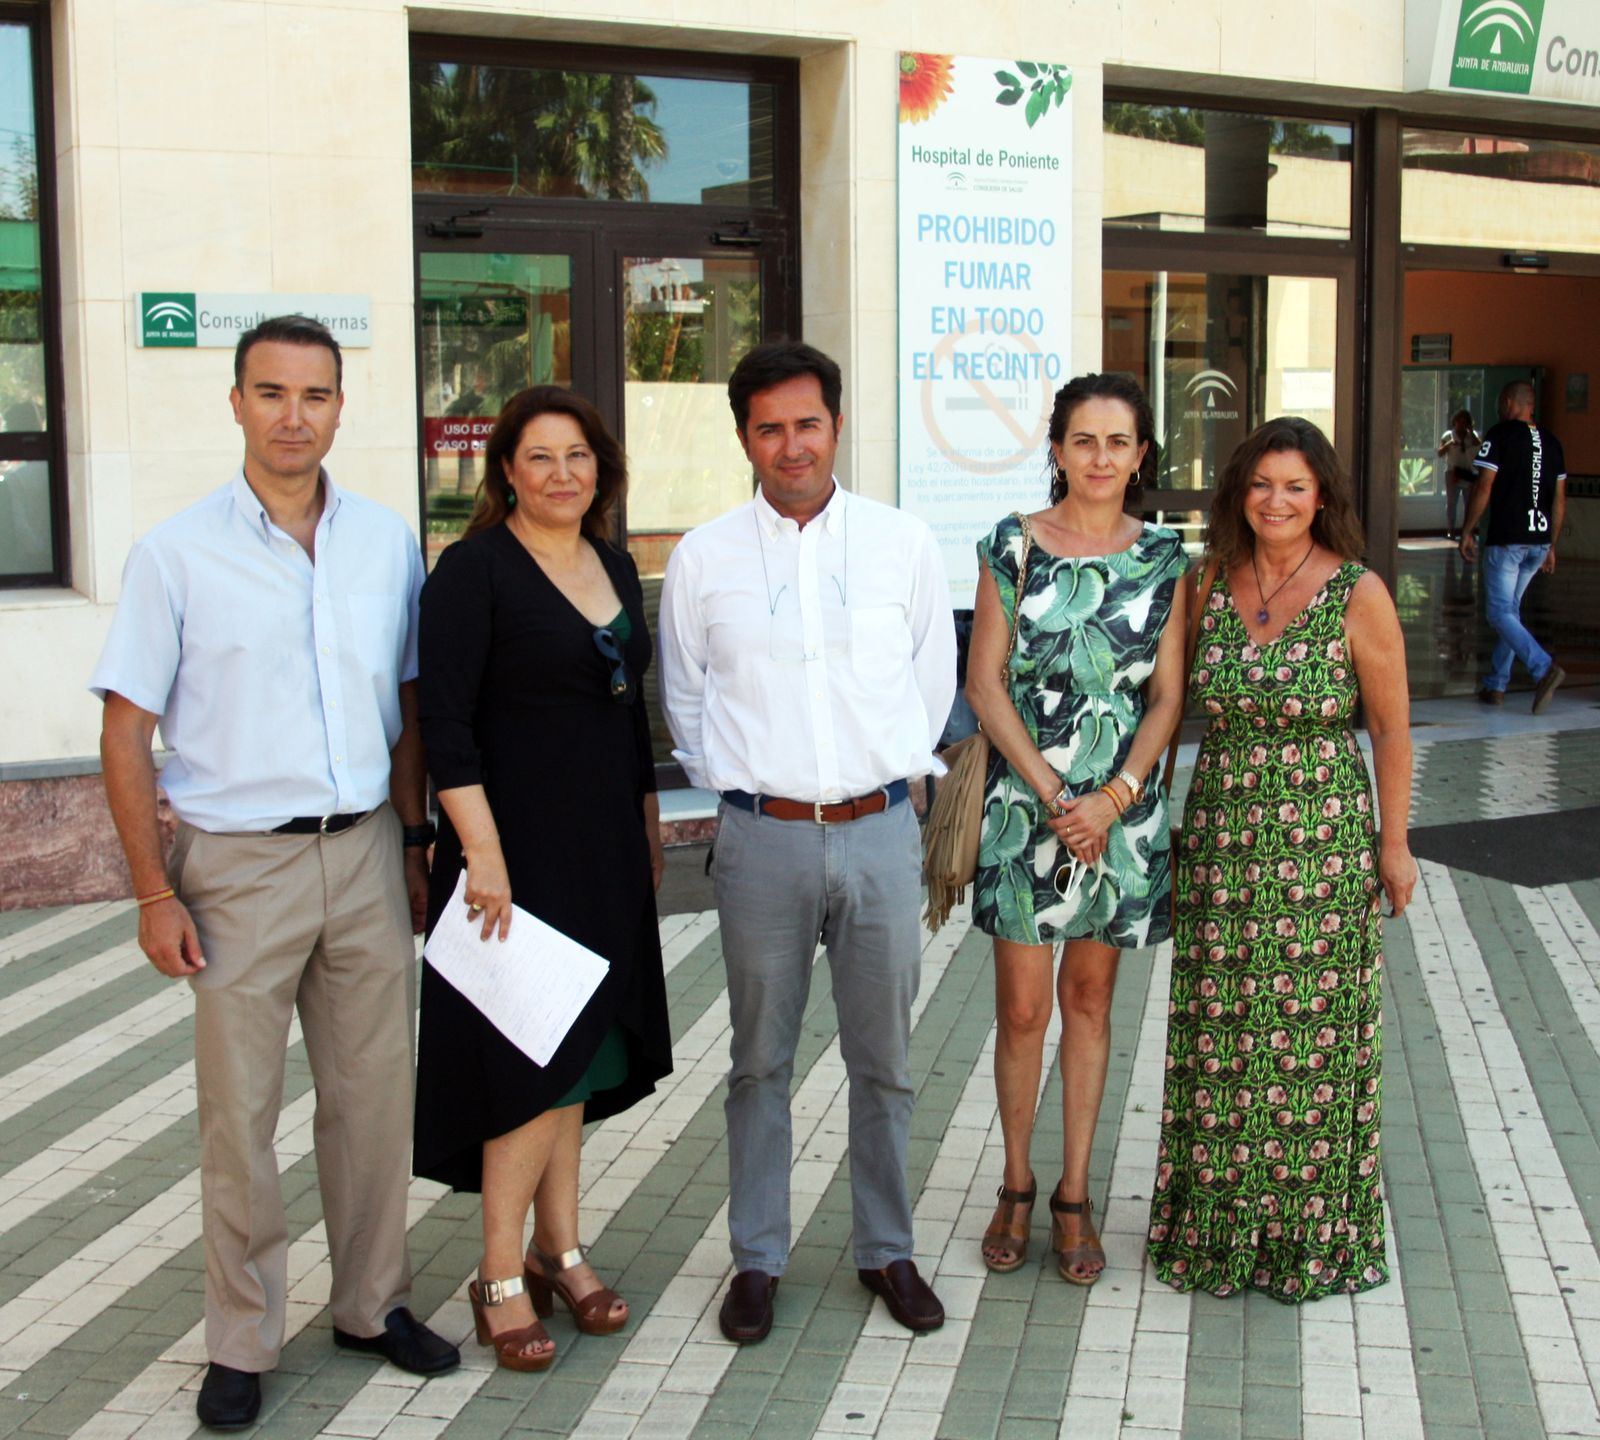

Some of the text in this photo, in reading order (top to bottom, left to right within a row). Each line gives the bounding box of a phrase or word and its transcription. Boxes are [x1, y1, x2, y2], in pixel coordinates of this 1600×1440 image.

[1456, 56, 1529, 75] JUNTA DE ANDALUCIA
[1546, 36, 1600, 78] Con
[912, 145, 1060, 170] Hospital de Poniente
[917, 214, 1055, 247] PROHIBIDO
[944, 261, 1031, 291] FUMAR
[931, 306, 1044, 336] EN TODO
[912, 352, 1061, 381] EL RECINTO
[444, 424, 470, 435] USO
[434, 440, 468, 451] CASO
[950, 446, 982, 457] informa
[984, 446, 996, 456] de
[997, 448, 1012, 458] que
[908, 462, 924, 474] Ley
[927, 462, 966, 473] 42/2010
[908, 478, 928, 488] todo
[929, 478, 938, 487] el
[940, 478, 969, 488] recinto
[917, 493, 930, 504] los
[932, 492, 994, 505] aparcamientos
[1003, 492, 1026, 502] zonas
[1527, 508, 1548, 532] 13
[938, 536, 960, 546] otivo
[962, 535, 972, 545] de
